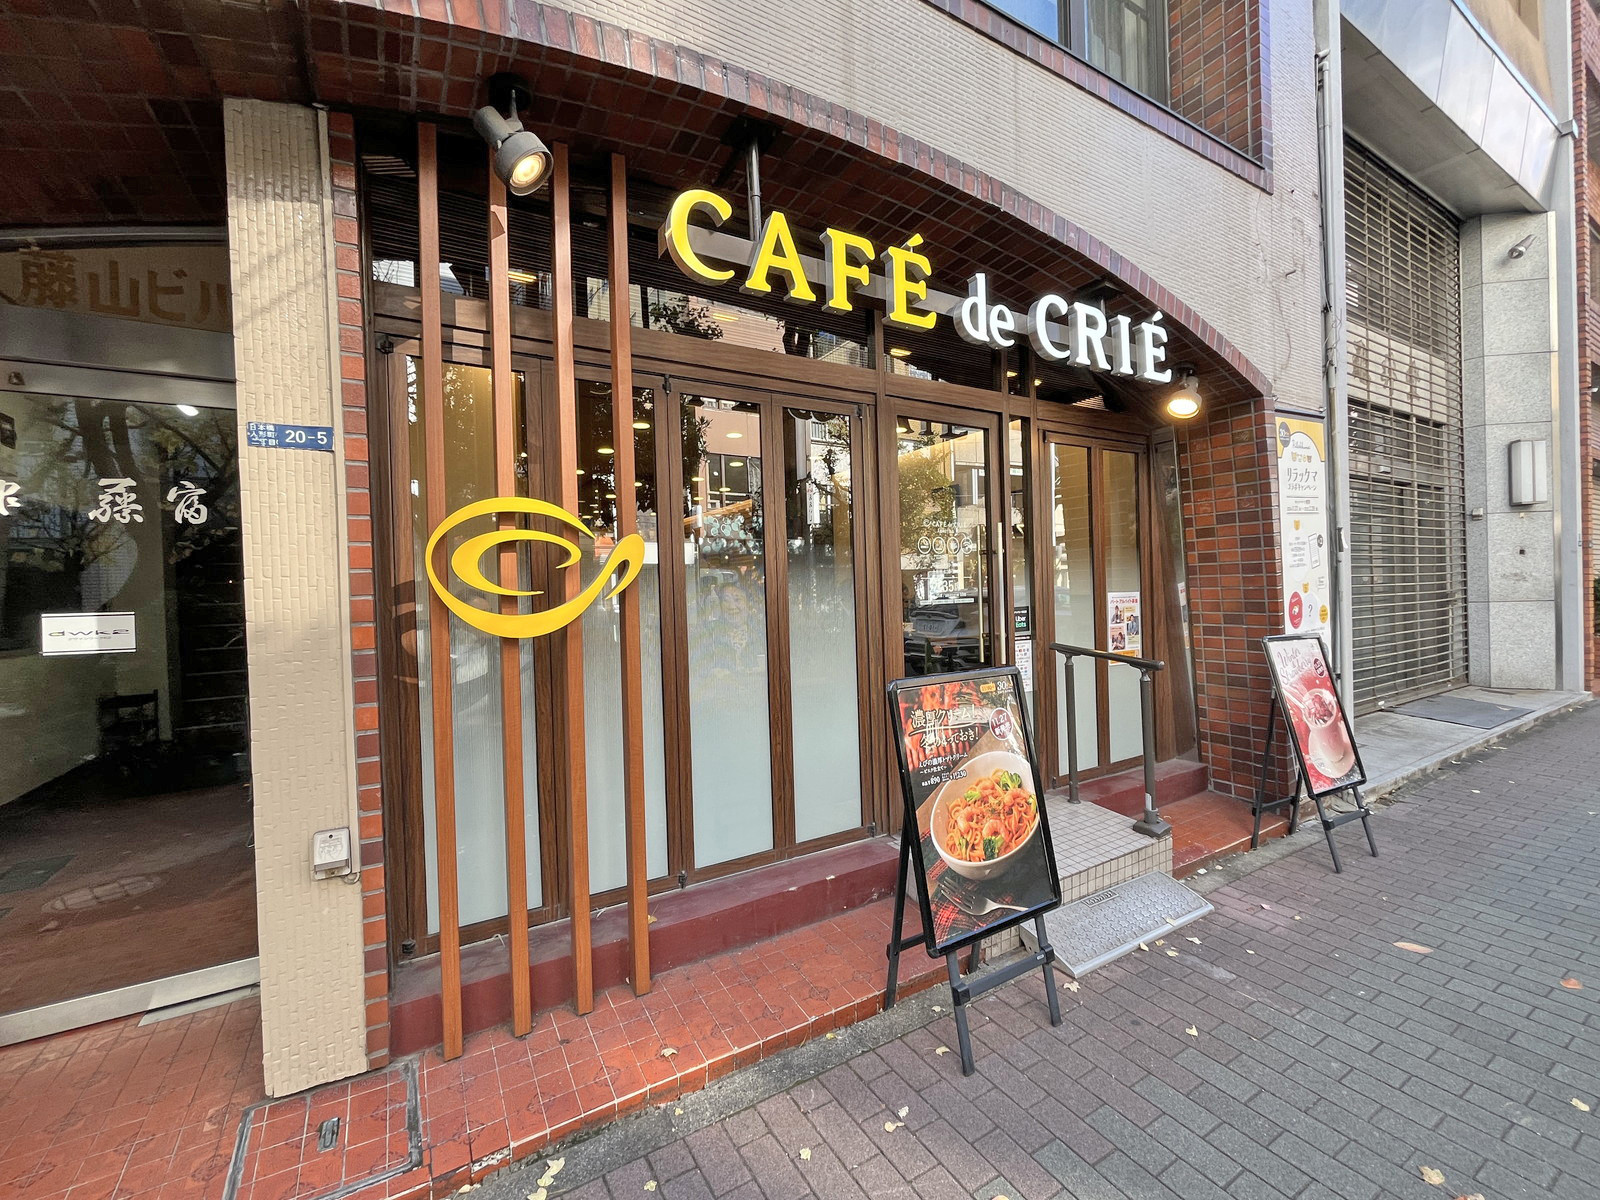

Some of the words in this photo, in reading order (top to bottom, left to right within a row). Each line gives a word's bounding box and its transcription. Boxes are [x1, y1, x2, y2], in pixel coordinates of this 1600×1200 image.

[20, 250, 229, 322] 藤山ビル
[664, 188, 938, 330] CAFÉ
[955, 273, 1015, 350] de
[1028, 294, 1173, 384] CRIÉ
[285, 430, 328, 445] 20-5
[1287, 467, 1318, 483] リラックマ
